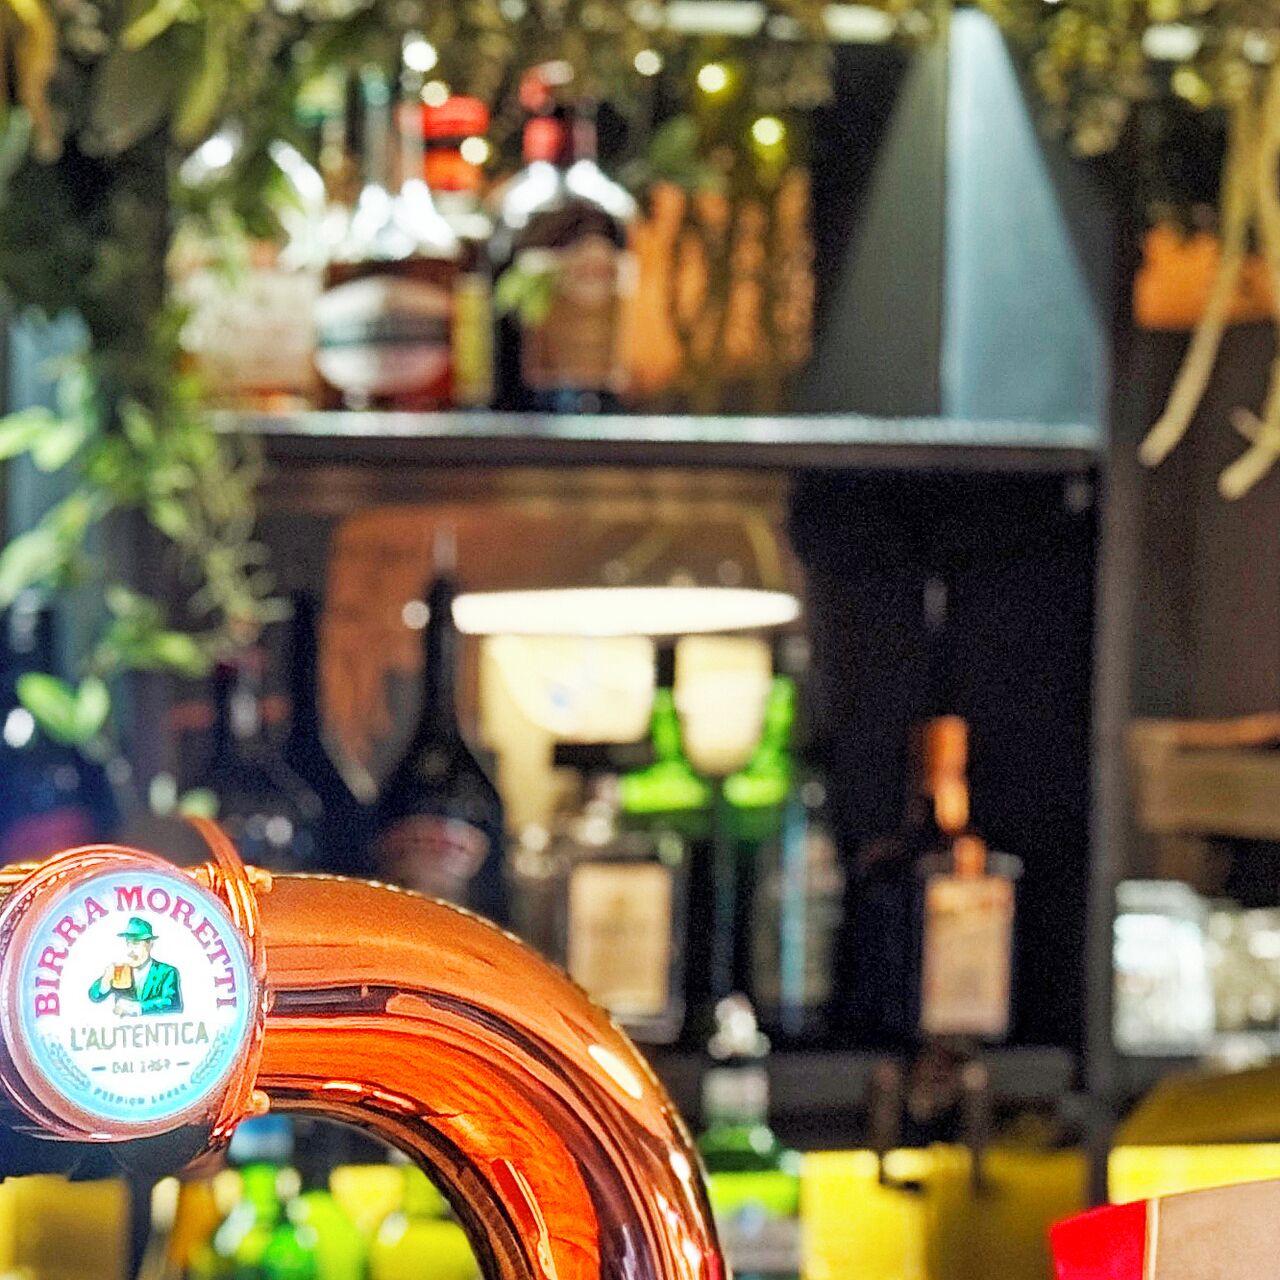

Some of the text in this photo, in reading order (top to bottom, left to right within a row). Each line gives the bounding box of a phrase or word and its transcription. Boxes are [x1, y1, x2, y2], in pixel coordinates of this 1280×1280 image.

[34, 885, 238, 1018] BIRRA MORETTI
[70, 1020, 209, 1052] L'AUTENTICA
